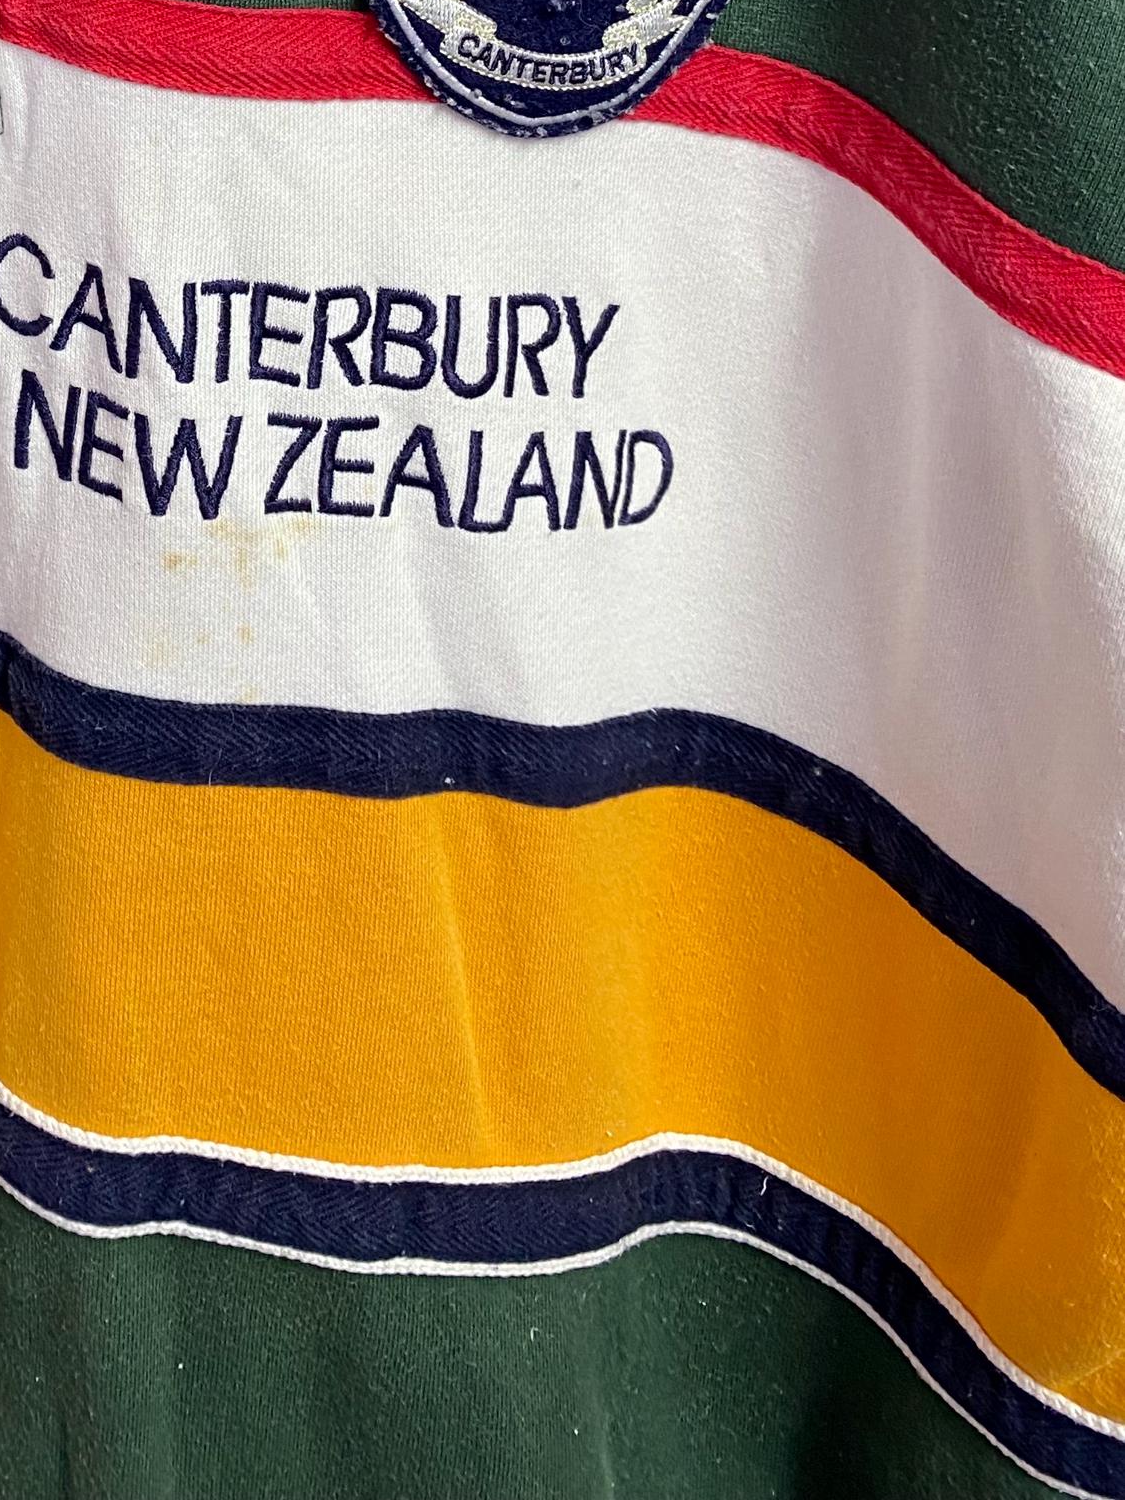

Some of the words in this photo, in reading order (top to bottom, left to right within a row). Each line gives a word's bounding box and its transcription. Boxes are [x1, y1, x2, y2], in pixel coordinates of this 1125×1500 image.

[458, 33, 639, 86] CANTERBURY
[13, 368, 244, 520] NEW
[263, 412, 674, 533] ZEALAND
